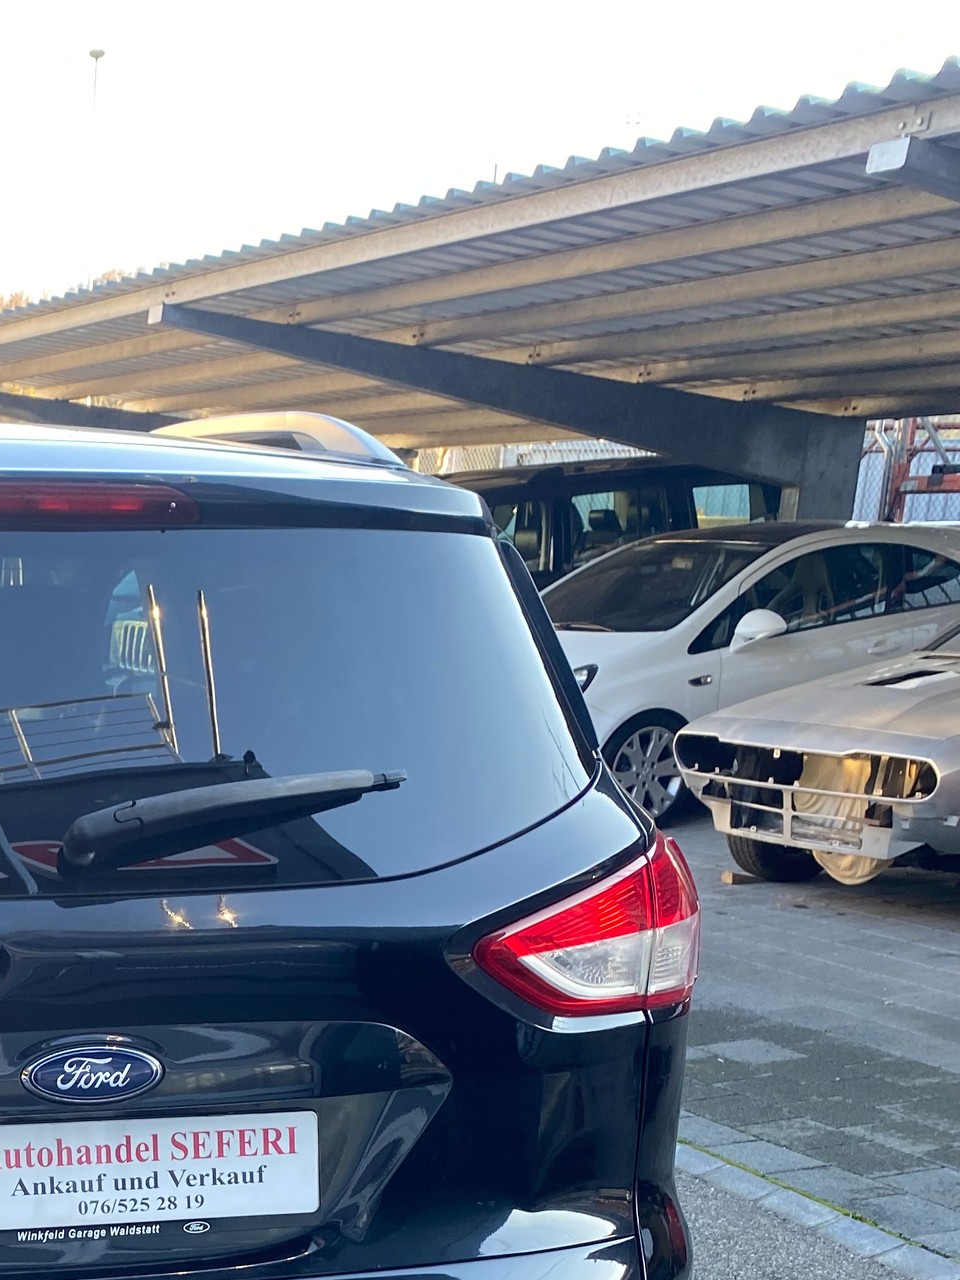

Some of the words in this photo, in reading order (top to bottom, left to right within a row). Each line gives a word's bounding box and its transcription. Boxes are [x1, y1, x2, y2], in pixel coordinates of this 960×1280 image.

[57, 1057, 132, 1090] Ford
[170, 1126, 299, 1161] SEFERI
[11, 1173, 107, 1197] Ankauf
[113, 1170, 160, 1192] und
[167, 1165, 268, 1189] Verkauf
[77, 1197, 151, 1216] 076/525
[156, 1195, 178, 1211] 28
[185, 1193, 205, 1210] 19
[16, 1229, 65, 1243] Winkfeld
[68, 1227, 107, 1239] Garage
[109, 1224, 161, 1237] Waldstatt
